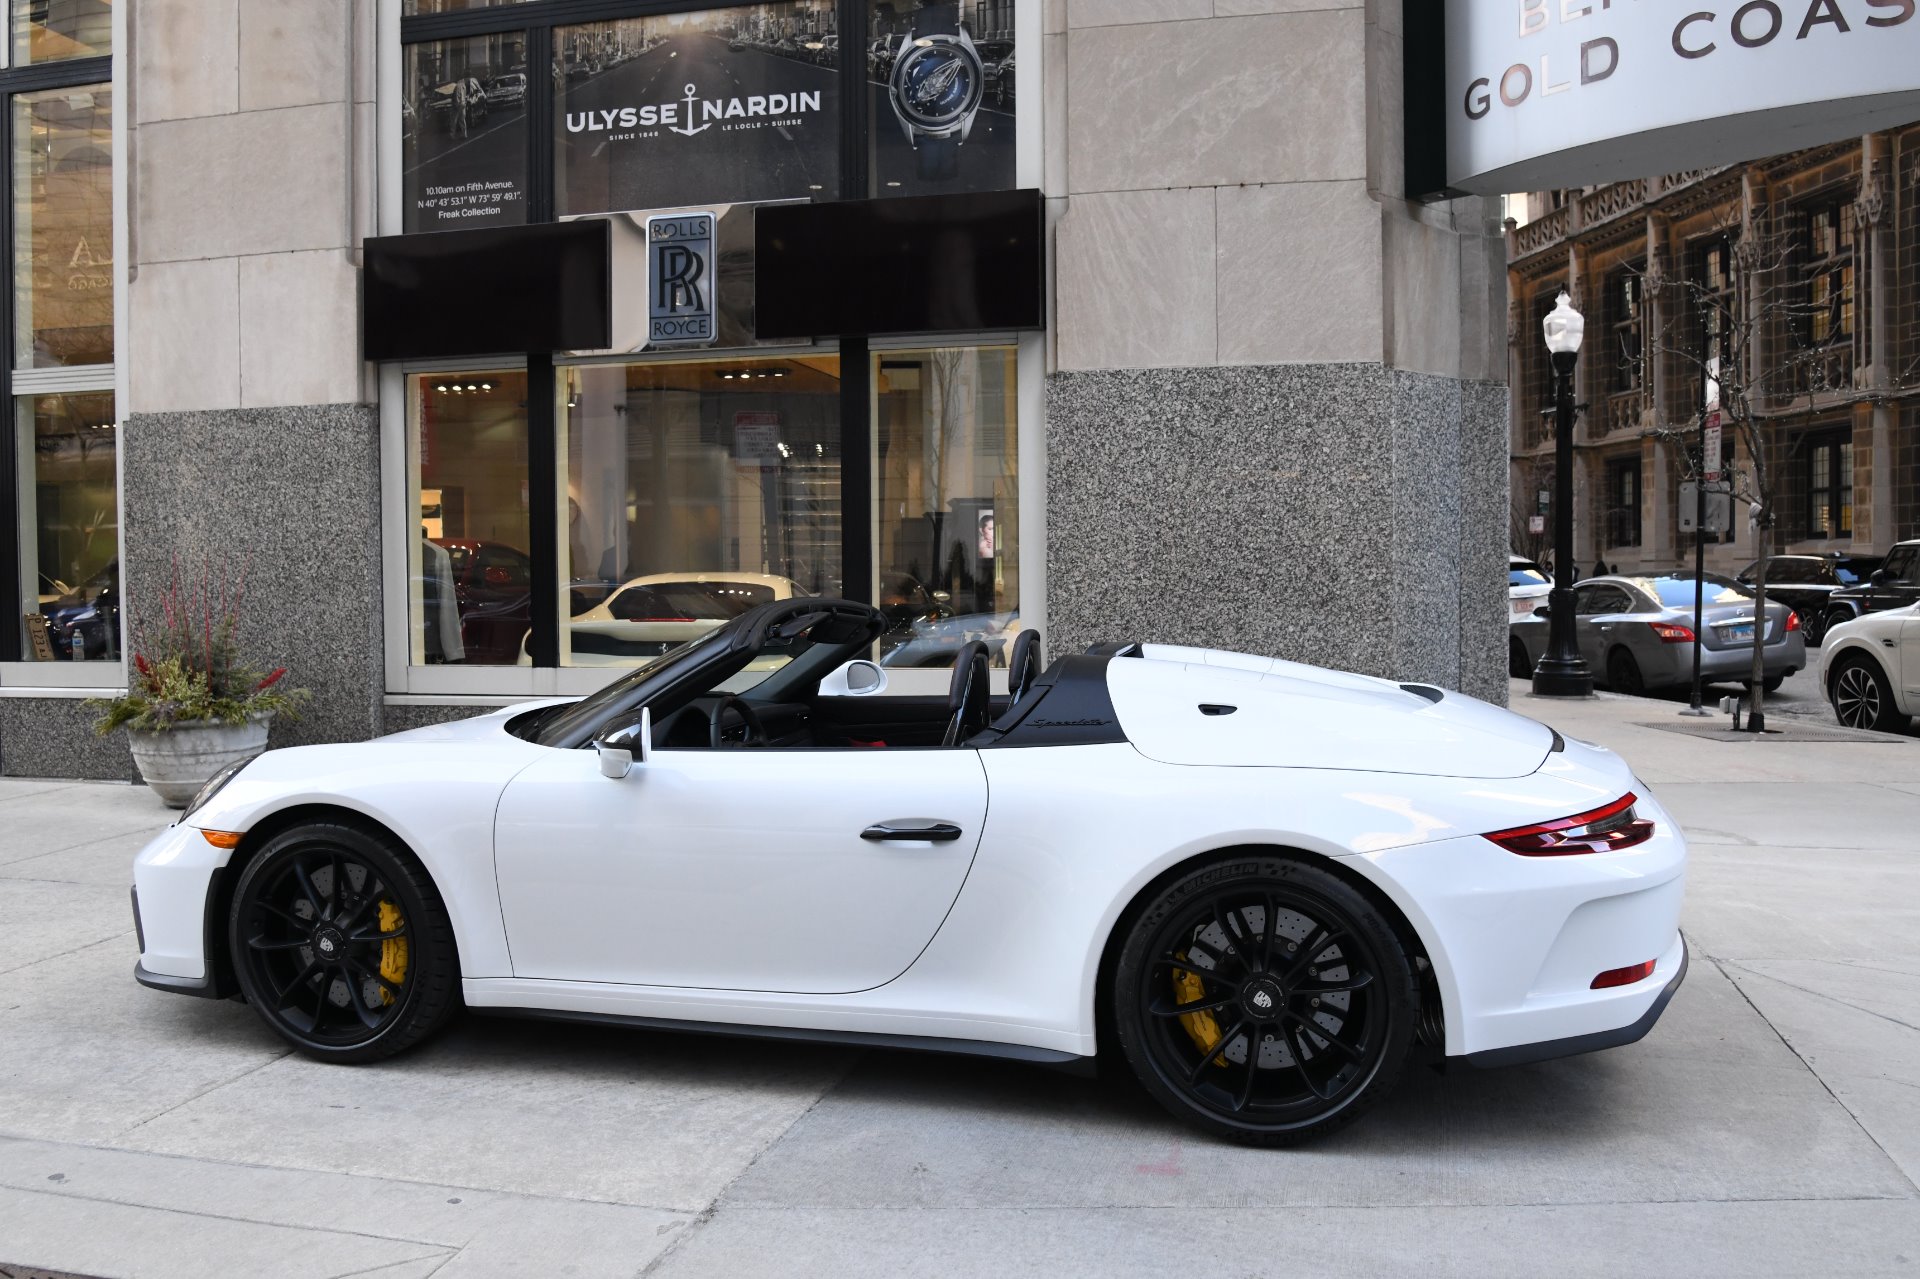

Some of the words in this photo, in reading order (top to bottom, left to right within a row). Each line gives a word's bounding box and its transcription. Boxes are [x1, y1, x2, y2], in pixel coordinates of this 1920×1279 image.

[1464, 36, 1619, 120] GOLD
[1672, 0, 1916, 59] COAS
[566, 103, 678, 133] ULYSSE
[702, 90, 821, 121] NARDIN
[735, 122, 761, 130] LOCLE
[771, 118, 802, 127] SUISSE
[609, 133, 635, 141] SINCE
[426, 186, 454, 196] 10.10am
[455, 185, 465, 193] on
[466, 182, 483, 192] Fifth
[484, 181, 514, 190] Avenue.
[417, 200, 424, 208] N
[468, 196, 477, 204] W
[438, 210, 461, 219] Freak
[461, 207, 501, 217] Collection
[653, 221, 706, 239] ROLLS
[654, 319, 707, 336] ROYCE
